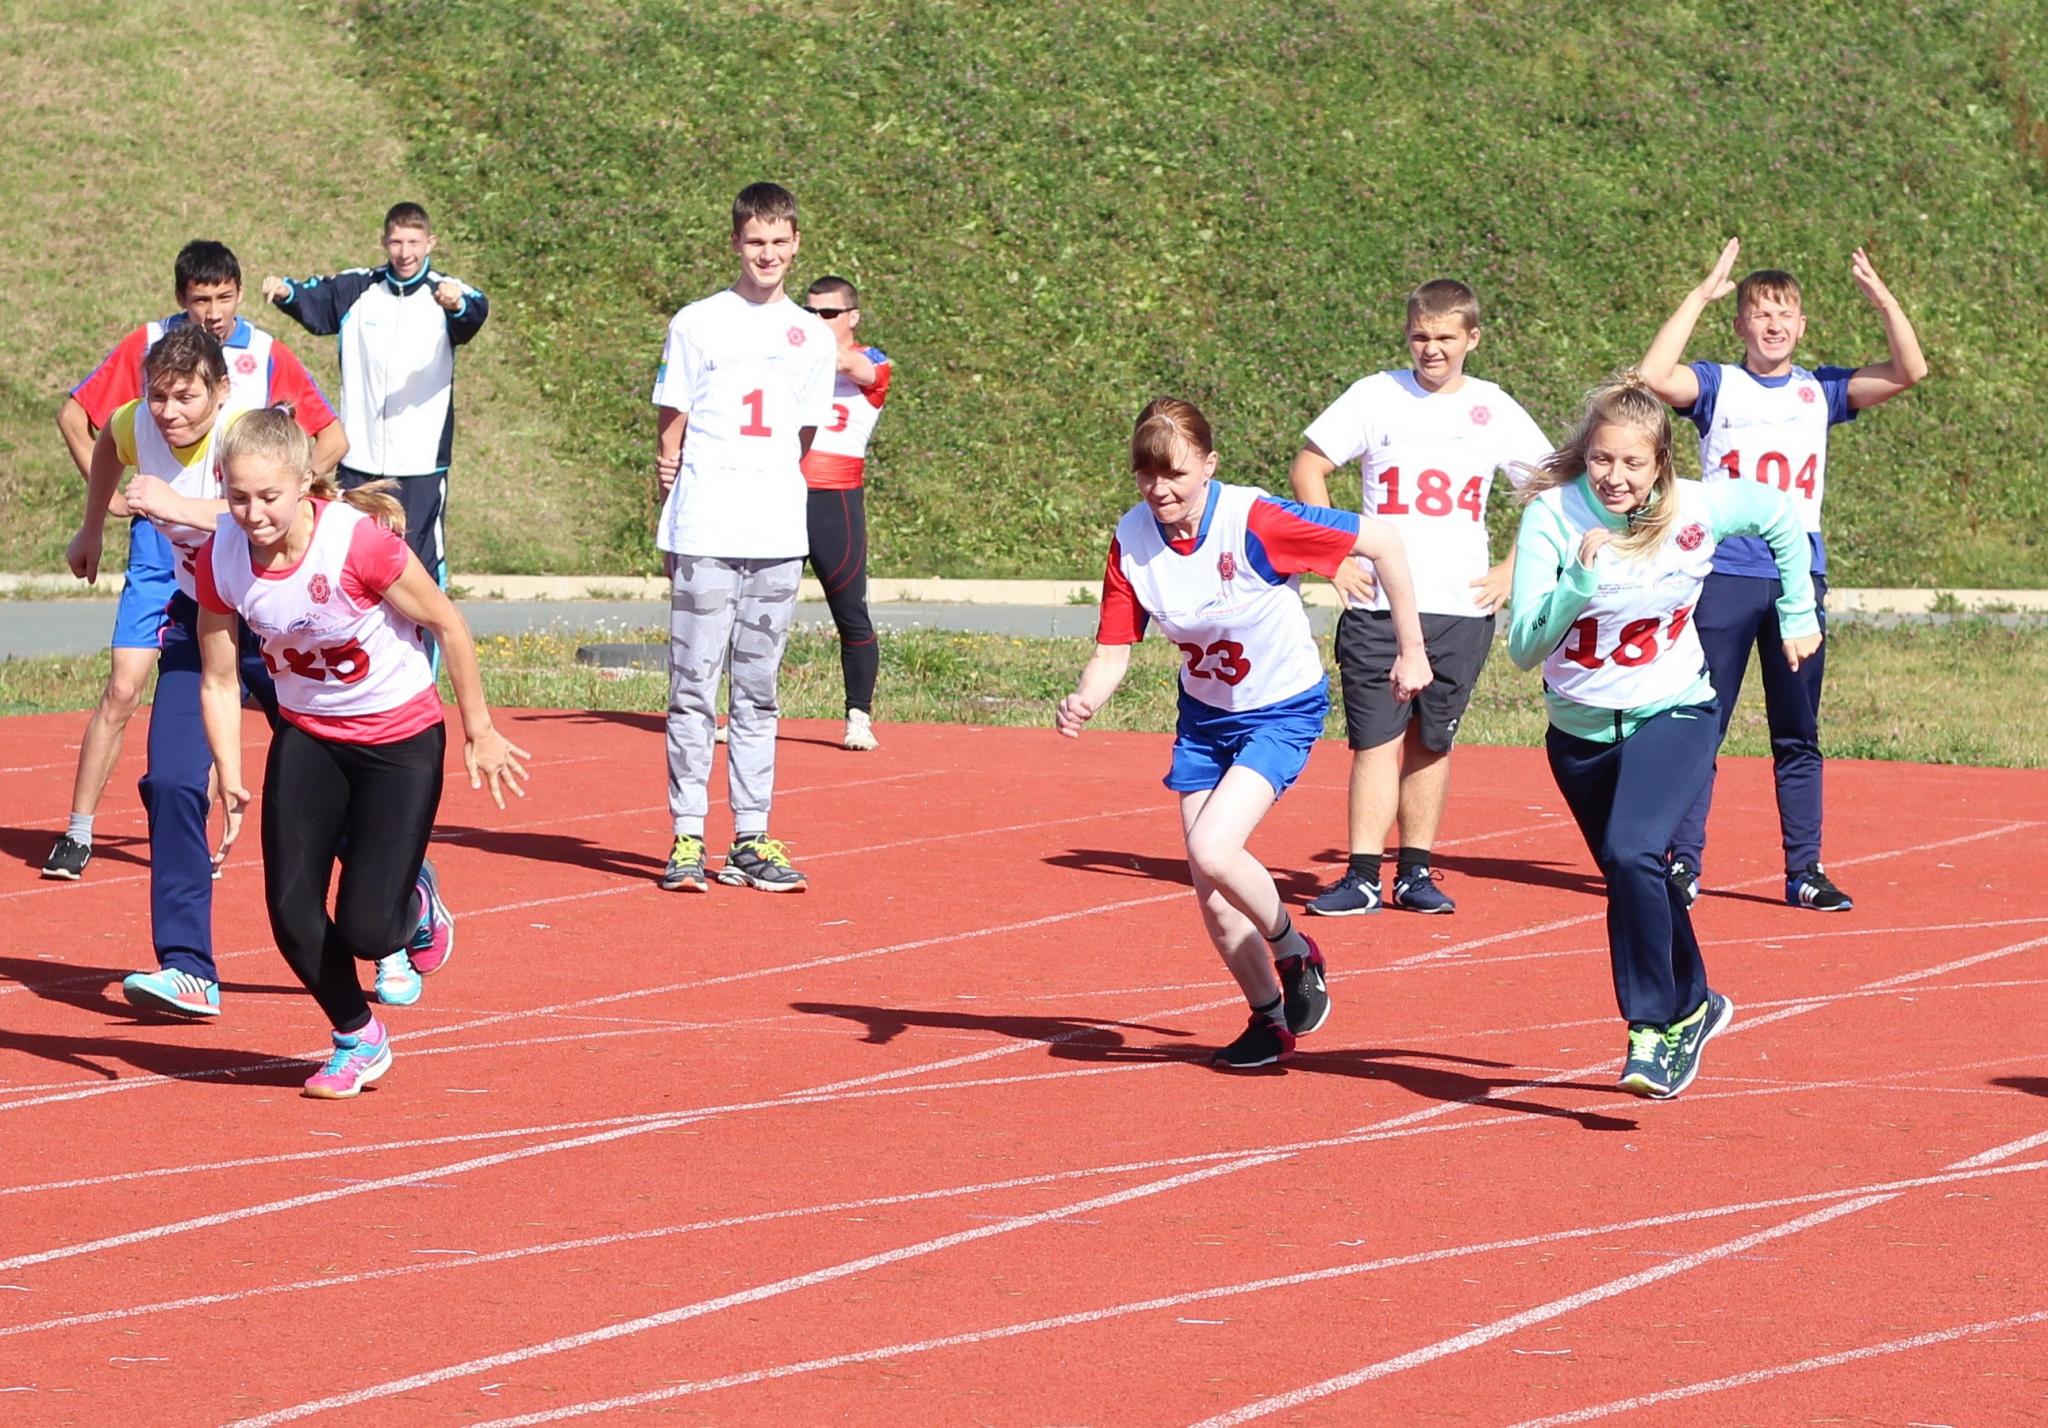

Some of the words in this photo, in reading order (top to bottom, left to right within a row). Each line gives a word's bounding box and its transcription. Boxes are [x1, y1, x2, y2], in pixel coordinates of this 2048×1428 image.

[740, 388, 772, 438] 1
[1377, 466, 1485, 523] 184
[1720, 449, 1818, 500] 104
[1173, 639, 1252, 687] 23
